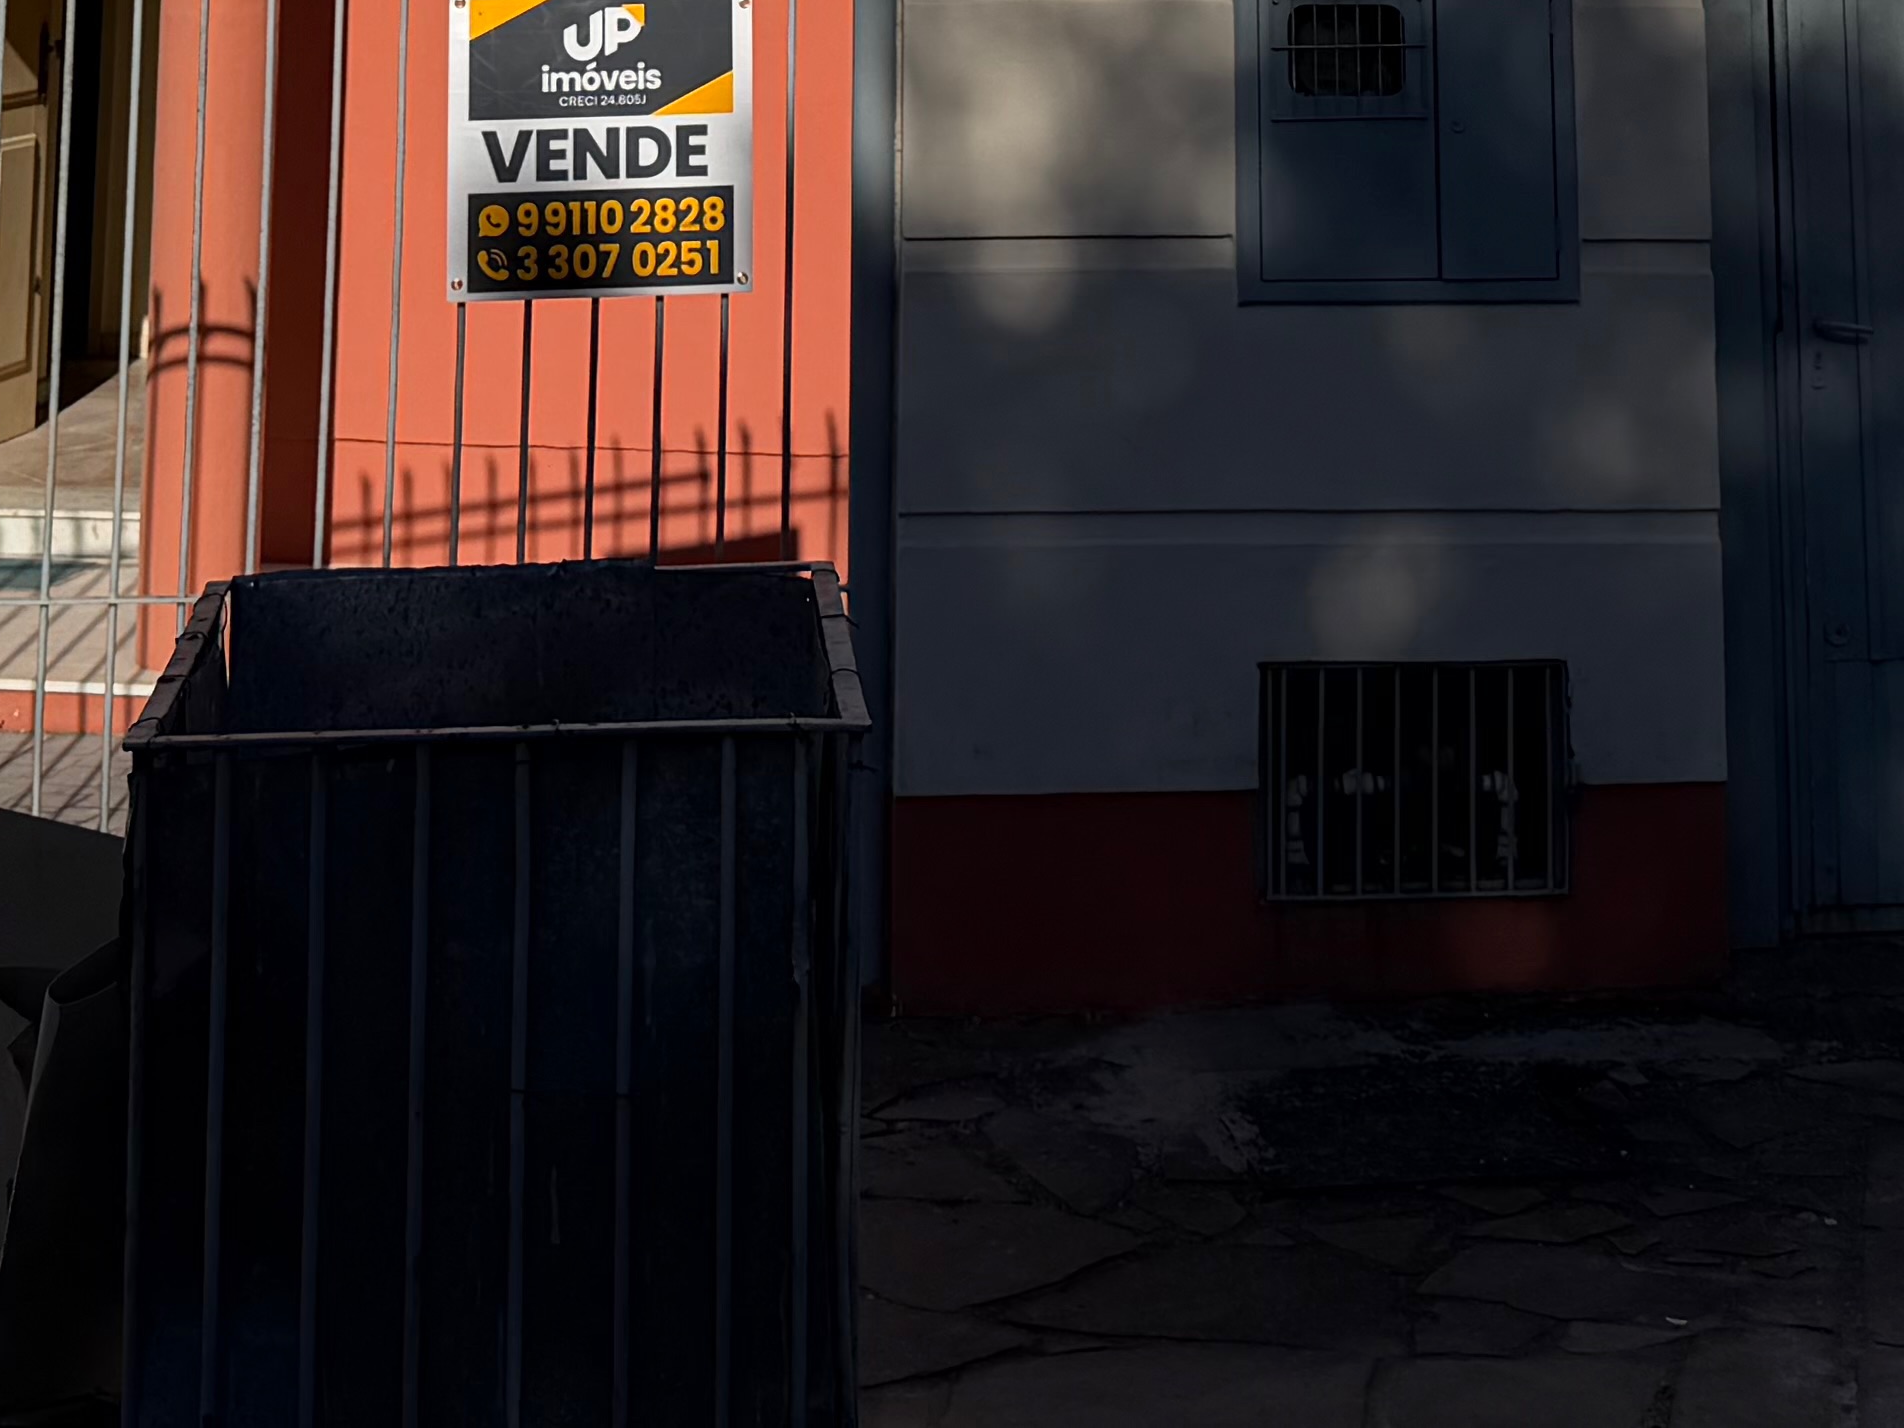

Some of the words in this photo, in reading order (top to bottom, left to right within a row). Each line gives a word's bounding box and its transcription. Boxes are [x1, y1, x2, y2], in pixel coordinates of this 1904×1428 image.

[541, 61, 662, 92] imóveis
[559, 96, 598, 106] CRECI
[481, 124, 709, 183] VENDE
[629, 196, 726, 233] 2828
[631, 241, 720, 277] 0251
